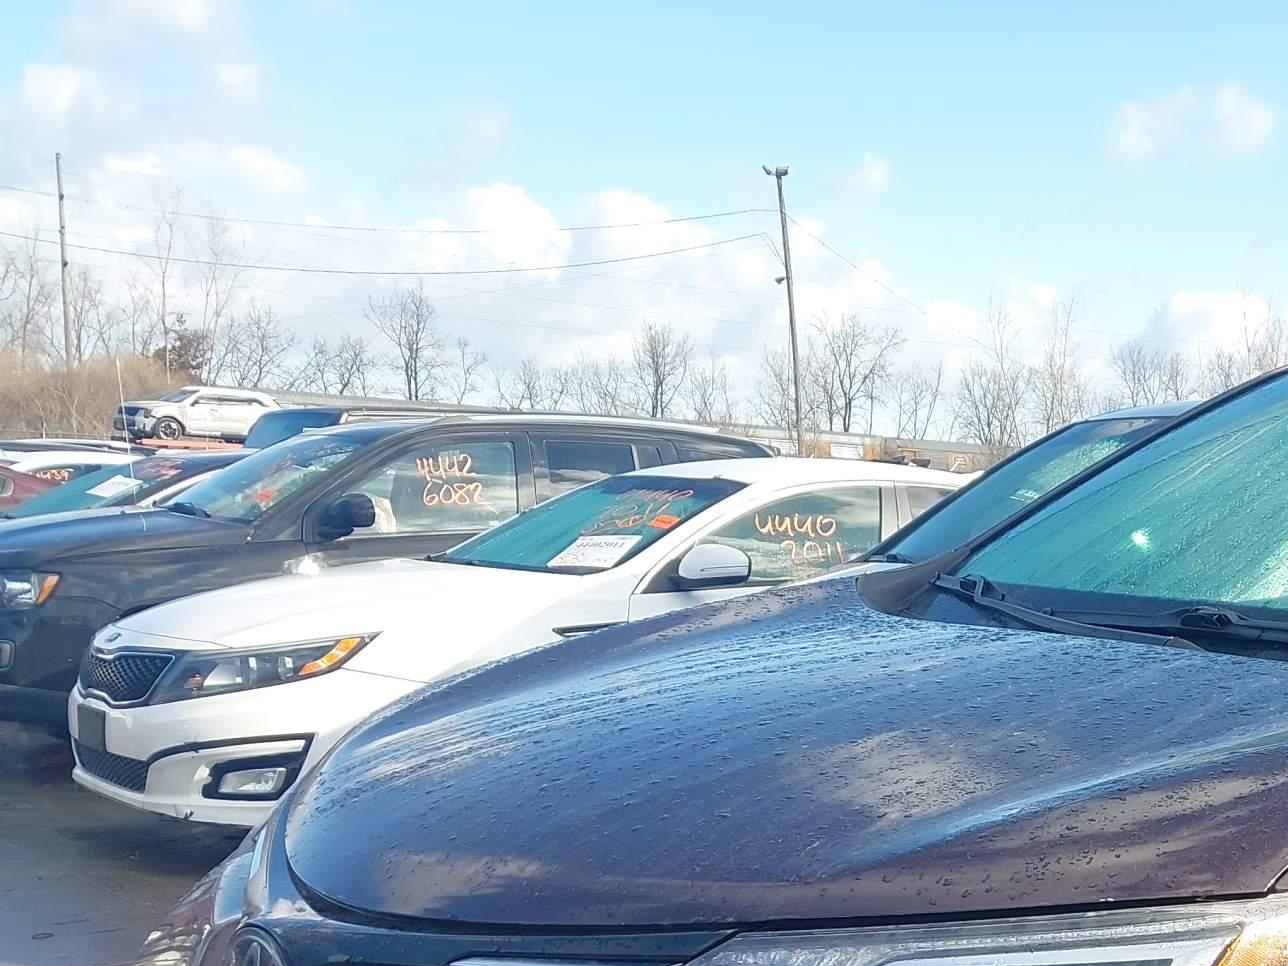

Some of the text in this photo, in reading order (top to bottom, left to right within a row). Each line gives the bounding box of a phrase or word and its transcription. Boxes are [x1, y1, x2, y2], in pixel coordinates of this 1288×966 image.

[416, 454, 476, 481] 4442
[423, 481, 497, 506] 6082
[755, 512, 837, 538] 4440
[781, 539, 843, 564] 2011
